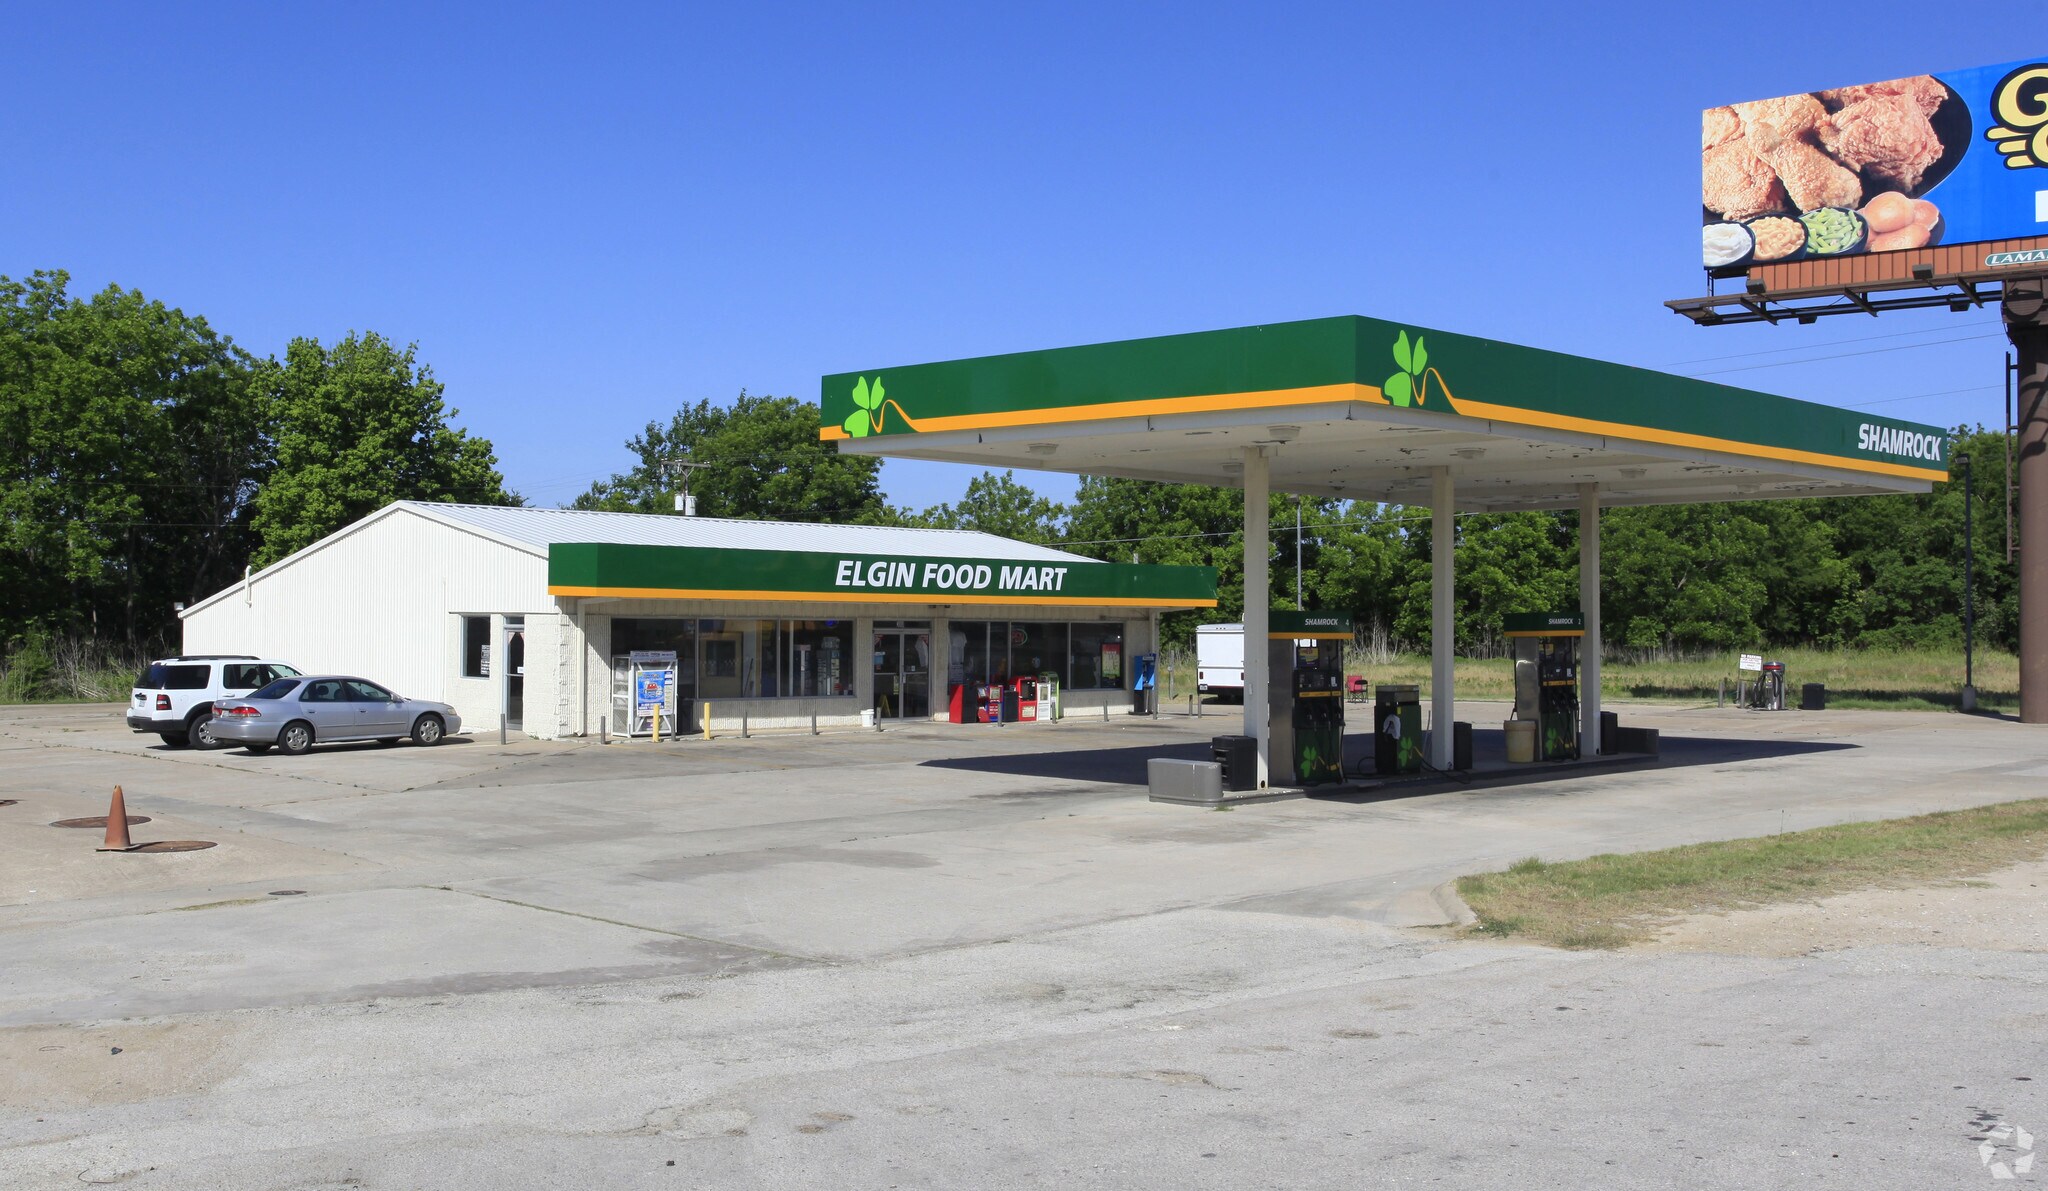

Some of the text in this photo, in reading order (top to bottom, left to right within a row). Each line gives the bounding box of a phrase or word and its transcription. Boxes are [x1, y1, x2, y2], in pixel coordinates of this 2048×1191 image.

[1991, 250, 2048, 264] LAMA
[1858, 423, 1941, 462] SHAMROCK
[835, 560, 1067, 591] ELGIN FOOD MART
[1304, 618, 1339, 626] SHAMROCK
